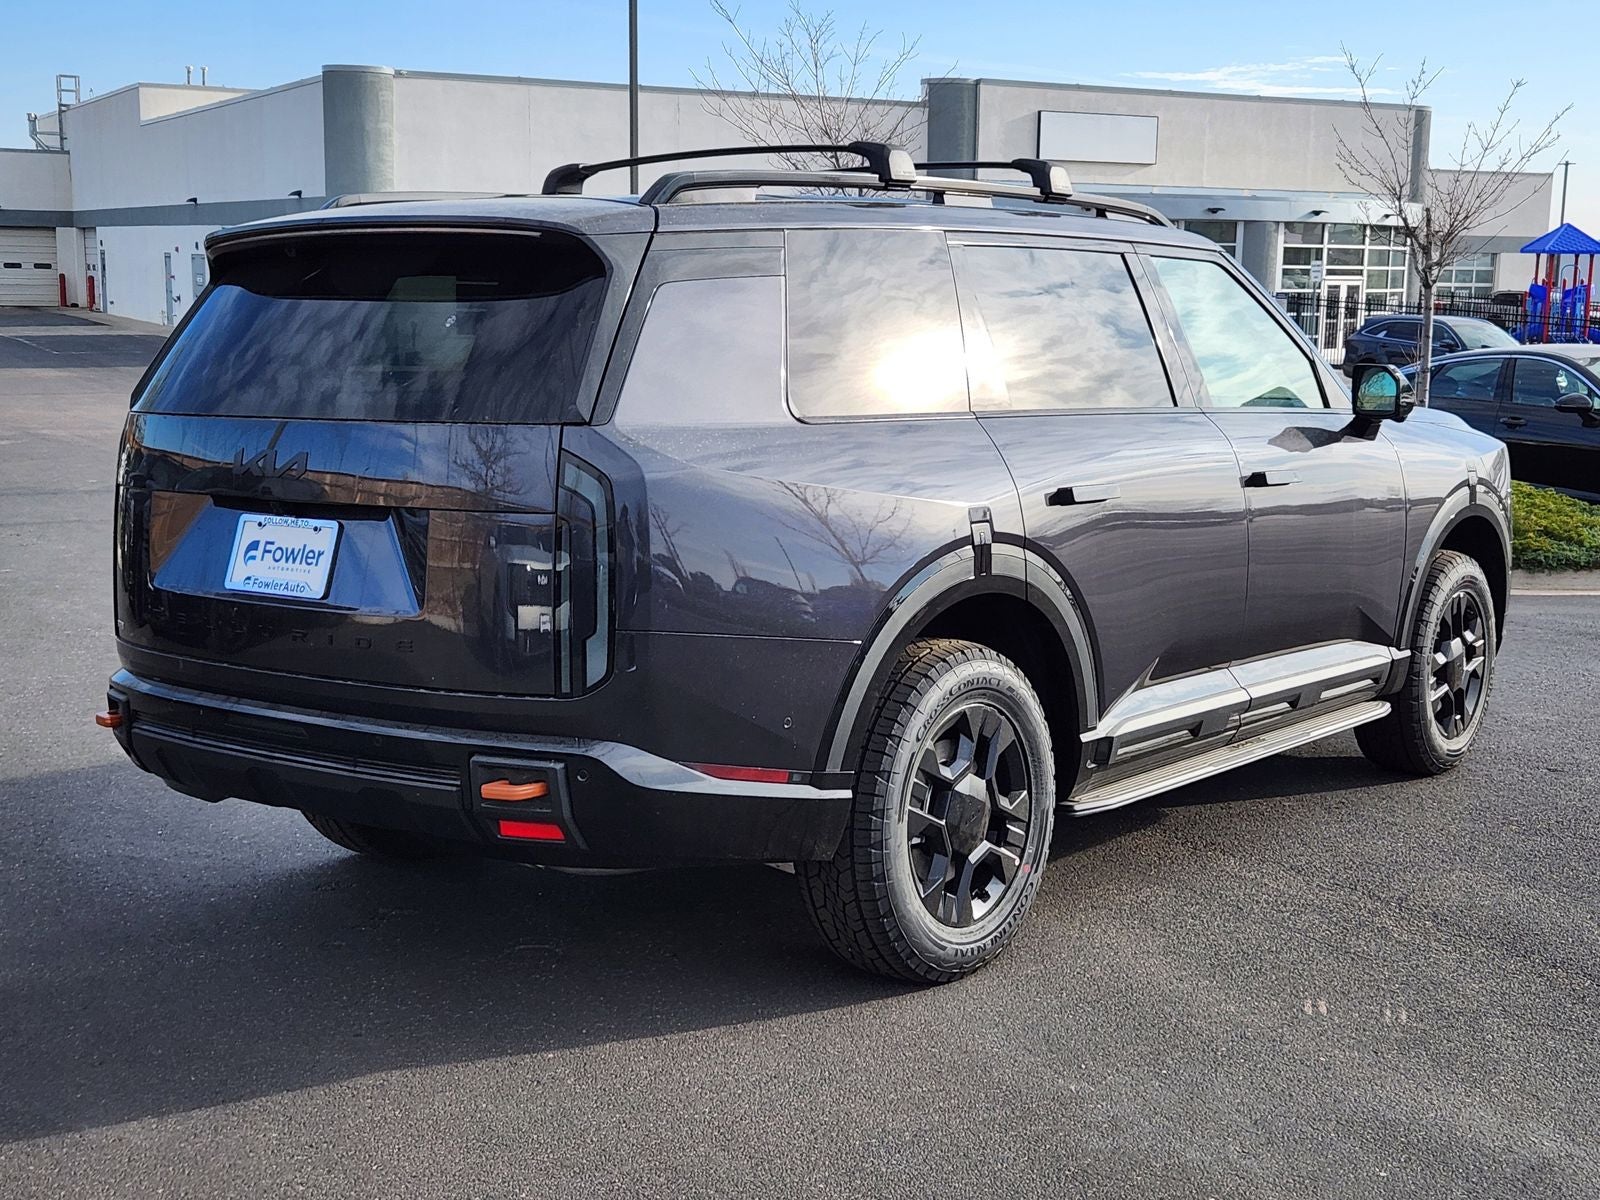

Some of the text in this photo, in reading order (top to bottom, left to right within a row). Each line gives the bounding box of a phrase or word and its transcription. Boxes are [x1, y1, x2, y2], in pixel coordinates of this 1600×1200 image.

[233, 447, 309, 480] KIA
[263, 516, 289, 525] FOLLOW
[260, 541, 325, 567] Fowler
[252, 577, 306, 593] FowlerAuto
